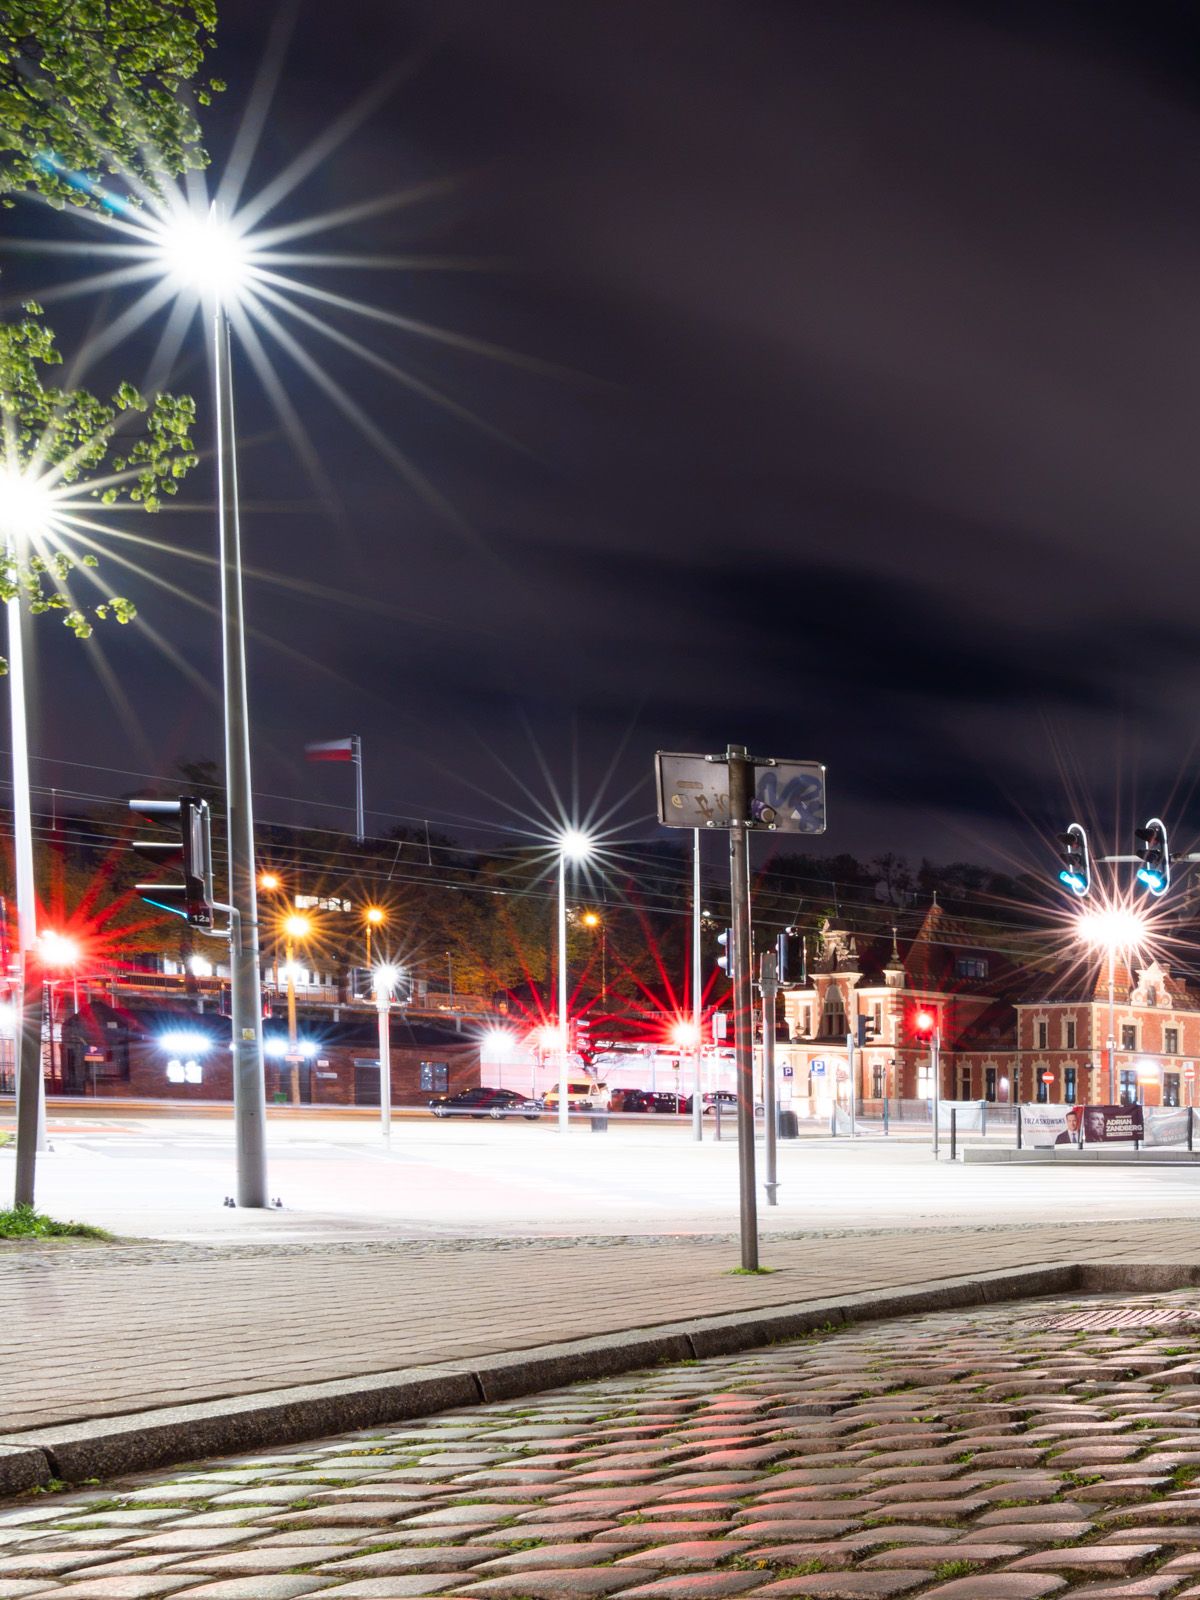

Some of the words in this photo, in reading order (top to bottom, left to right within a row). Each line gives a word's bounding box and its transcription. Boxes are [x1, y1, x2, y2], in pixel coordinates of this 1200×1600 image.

[193, 914, 210, 923] 12a
[814, 1061, 823, 1071] P
[785, 1067, 792, 1076] P
[1106, 1118, 1132, 1126] ADRIAN
[1106, 1124, 1143, 1132] ZANDBERG
